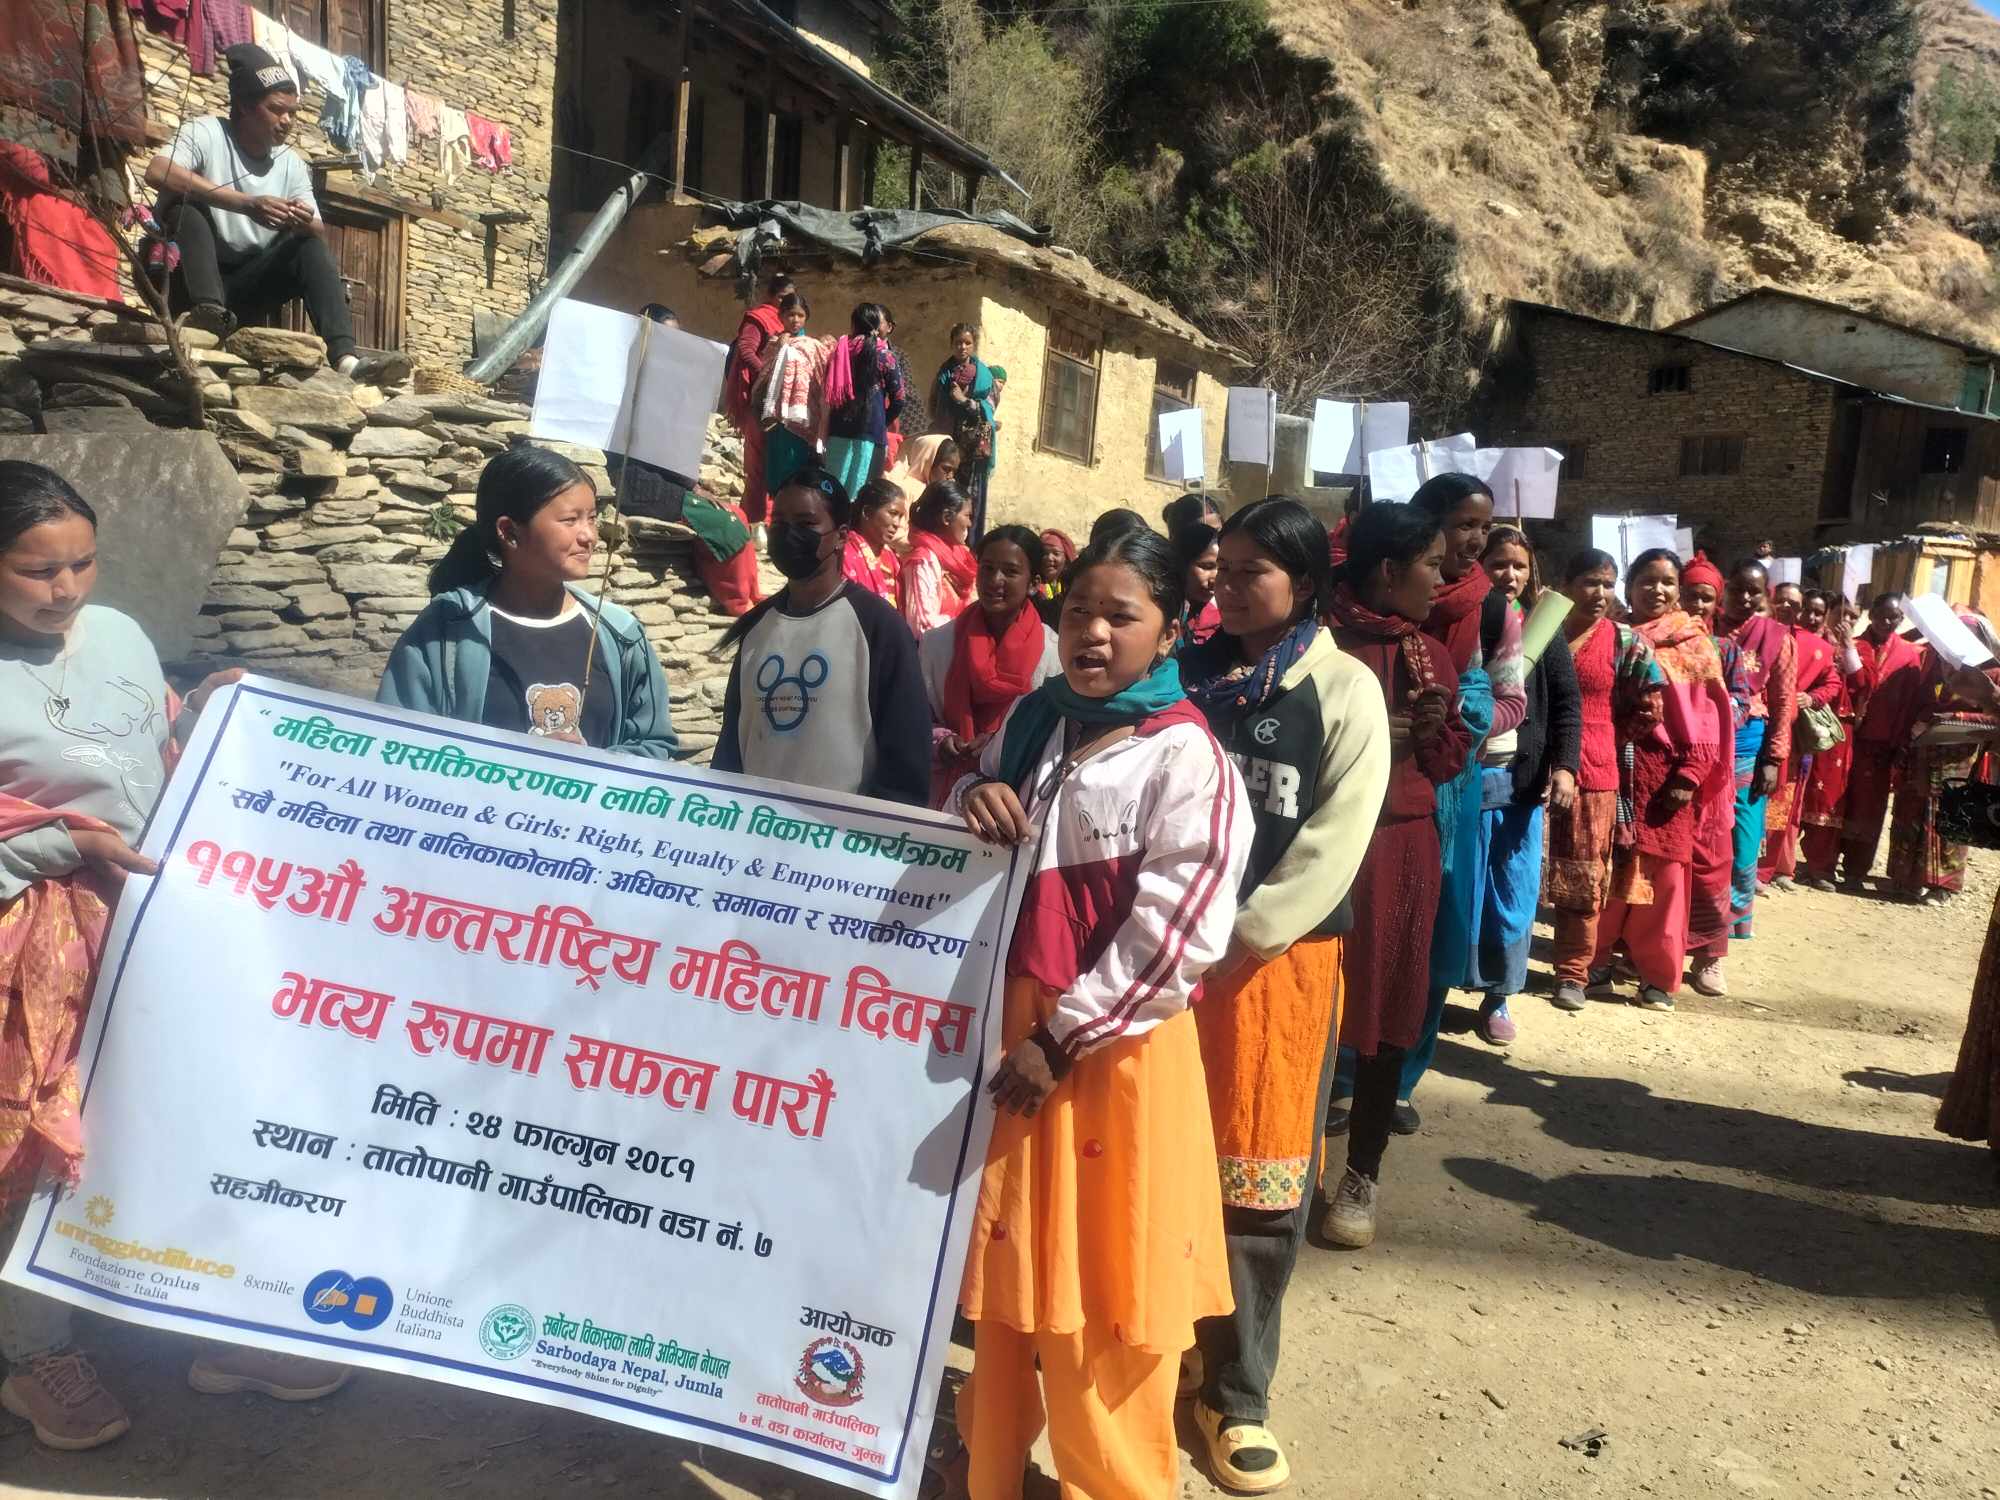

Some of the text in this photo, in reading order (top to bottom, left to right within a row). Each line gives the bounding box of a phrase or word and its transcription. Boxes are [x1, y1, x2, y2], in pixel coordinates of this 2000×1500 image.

[272, 715, 377, 757] महिला
[380, 739, 598, 804] शसक्तिकरणका
[600, 785, 677, 819] लागि
[677, 792, 744, 832] दिगो
[746, 804, 839, 849] विकास
[842, 829, 972, 874] कार्यक्रम
[336, 775, 377, 800] All
[383, 783, 469, 820] Women
[475, 805, 498, 825] &
[504, 810, 571, 841] Girls:
[576, 824, 644, 859] Right,
[652, 839, 740, 877] Equalty
[744, 857, 765, 877] &
[770, 861, 952, 911] Empowerment"
[231, 788, 275, 815] सबै
[277, 800, 363, 835] महिला
[364, 820, 419, 847] तथा
[712, 890, 801, 927] समानता
[805, 908, 825, 931] र
[828, 913, 971, 959] सशक्तीकरण
[371, 884, 662, 993] अन्तर्राष्ट्रिय
[668, 938, 832, 1024] महिला
[839, 964, 978, 1056] दिवस
[270, 971, 838, 1140] भव्य रूपमा सफल पारौं
[370, 1083, 442, 1126] मिति
[465, 1111, 503, 1140] २४
[512, 1119, 621, 1168] फाल्गुन
[624, 1146, 696, 1184] २०८१
[209, 1172, 347, 1218] सहजीकरण
[251, 1118, 339, 1161] स्थान
[361, 1143, 494, 1193] तातोपानी
[498, 1172, 654, 1230] गाउँपालिका
[658, 1208, 711, 1243] वडा
[753, 1231, 774, 1258] ७
[69, 1247, 201, 1292] Fondazione Onlus
[84, 1269, 121, 1289] Pistoia
[134, 1283, 169, 1301] Italia
[243, 1274, 295, 1297] 8xmille
[400, 1305, 465, 1328] Buddhista
[406, 1287, 454, 1310] Unione
[395, 1320, 443, 1341] Italiana
[579, 1318, 628, 1353] विकासका
[628, 1333, 656, 1360] लागि
[655, 1340, 700, 1372] अभियान
[700, 1348, 732, 1380] नेपाल
[799, 1304, 896, 1348] आयोजक
[536, 1339, 724, 1399] Sarbodaya Nepal, Jumla
[585, 1371, 610, 1384] Shine
[612, 1377, 625, 1388] for
[755, 1391, 810, 1418] तातोपानी
[767, 1419, 790, 1437] वडा
[851, 1444, 887, 1466] जुम्ला
